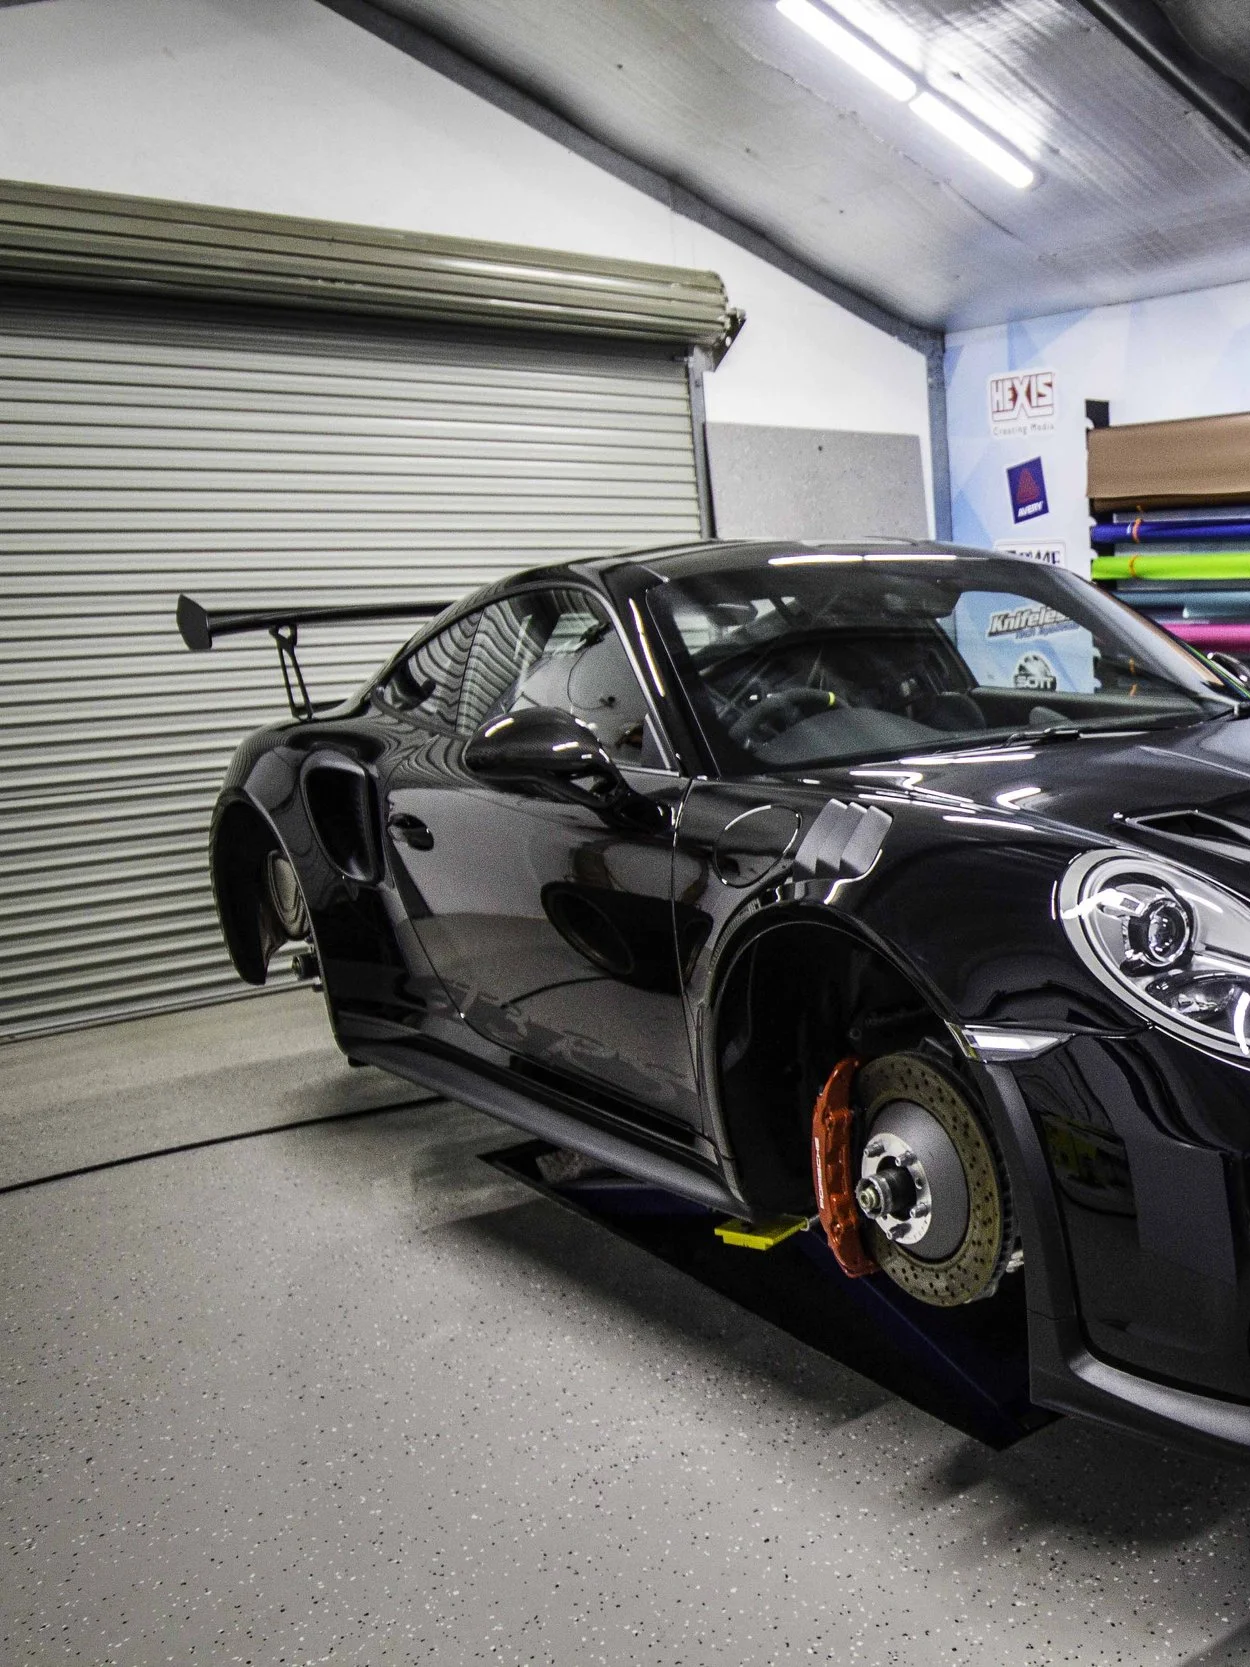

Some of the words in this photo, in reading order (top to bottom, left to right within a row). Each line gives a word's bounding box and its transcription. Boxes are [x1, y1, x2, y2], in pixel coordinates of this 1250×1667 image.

[990, 371, 1054, 422] HEXIS
[1017, 500, 1044, 518] AVERY
[989, 606, 1071, 634] Knifele
